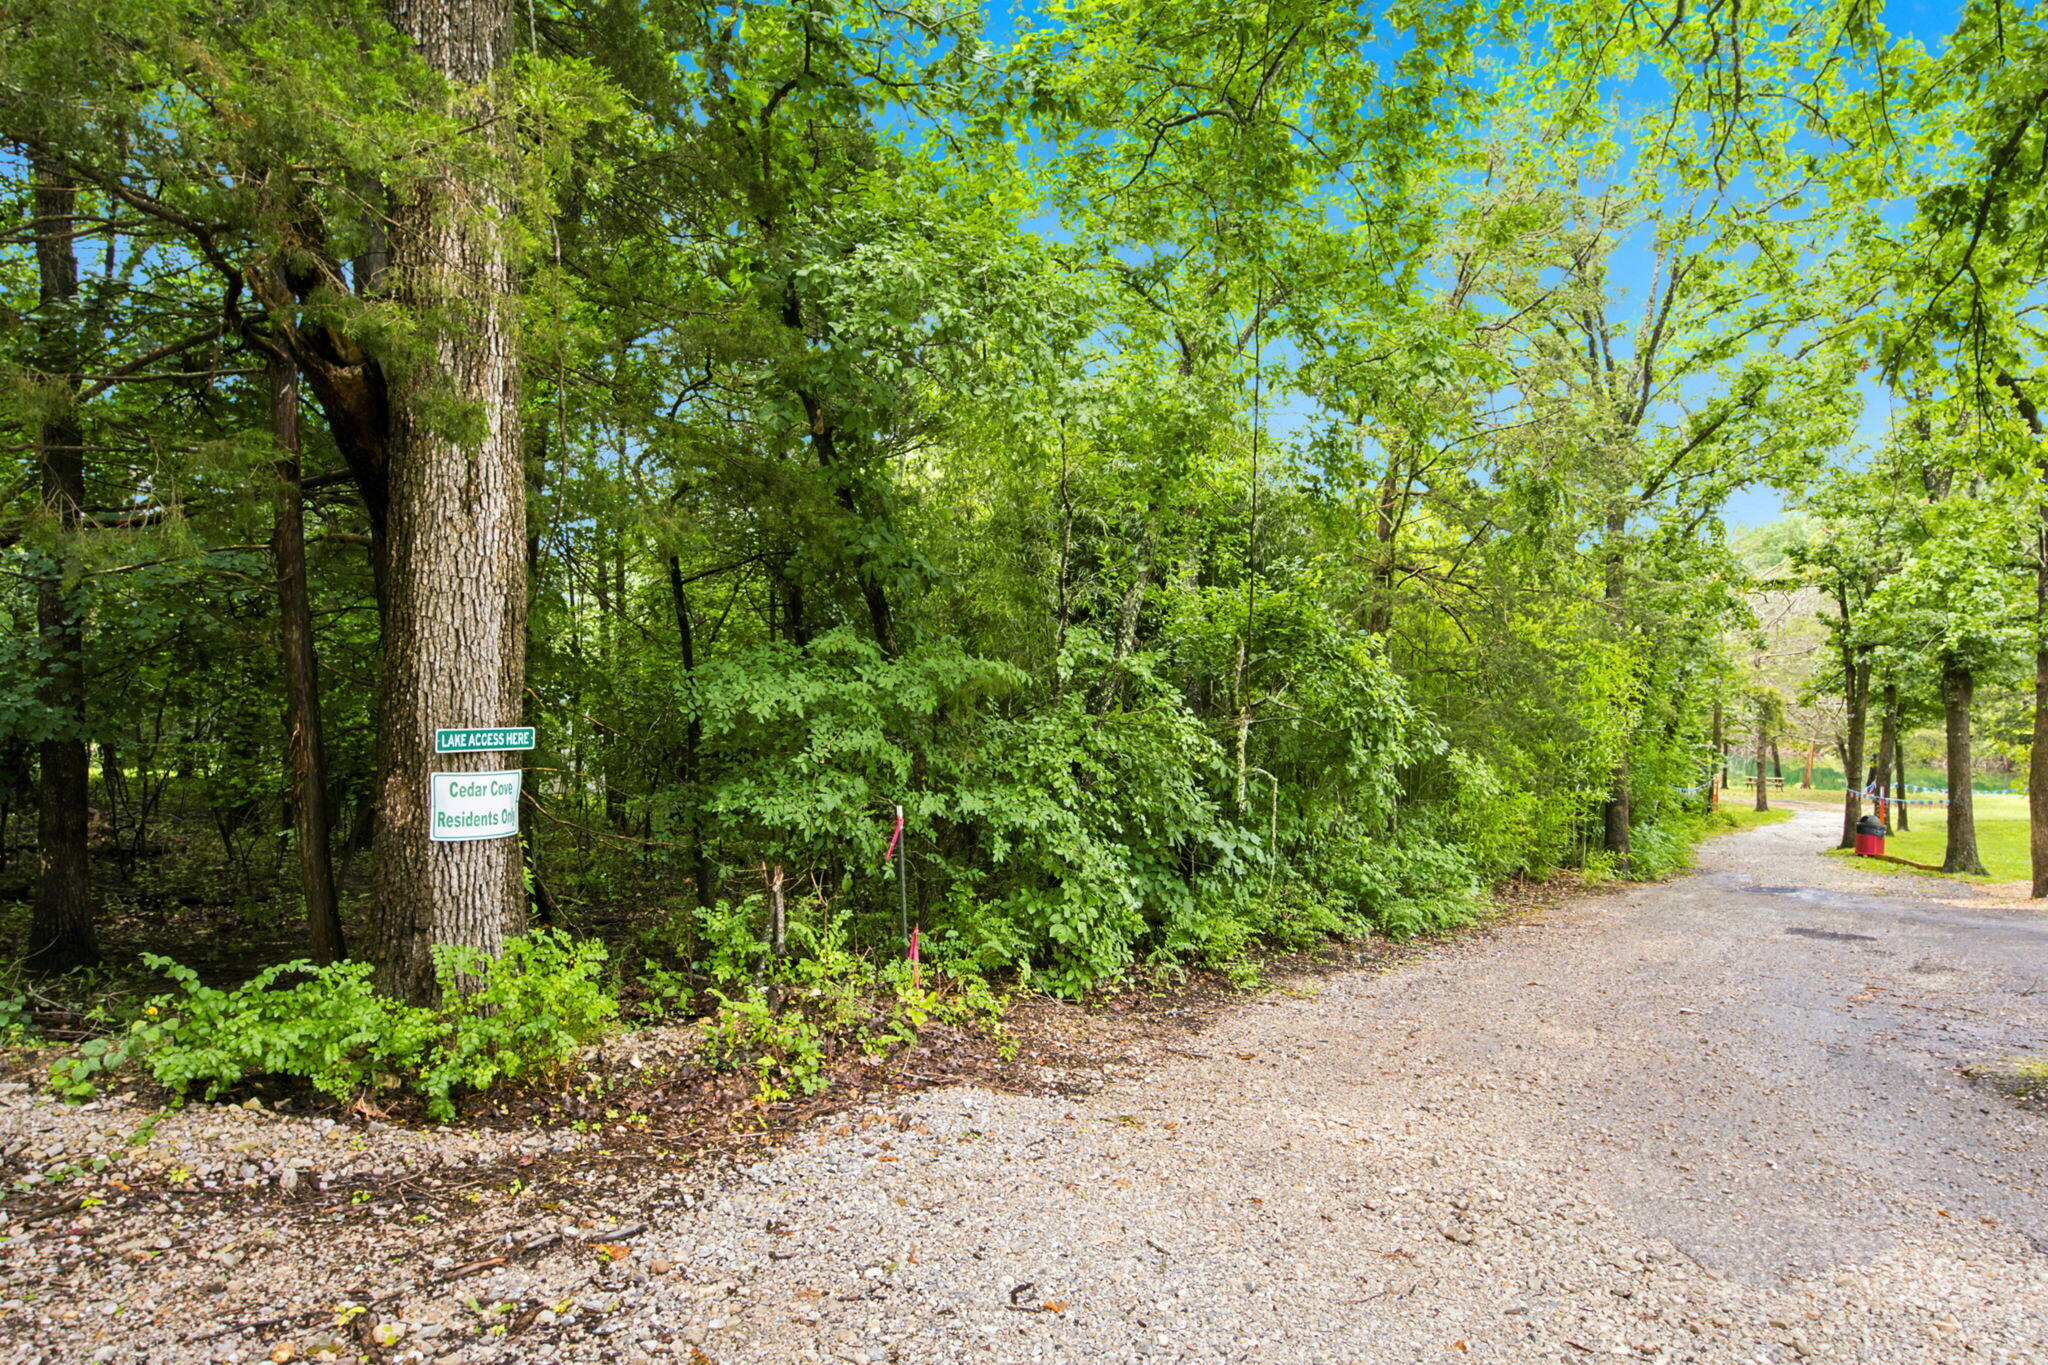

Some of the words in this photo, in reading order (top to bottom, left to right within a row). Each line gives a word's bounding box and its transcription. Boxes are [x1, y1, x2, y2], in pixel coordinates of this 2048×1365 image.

[441, 734, 467, 748] LAKE
[468, 733, 505, 747] ACCESS
[506, 732, 530, 745] HERE
[449, 781, 487, 798] Cedar
[490, 780, 513, 796] Cove
[437, 810, 499, 828] Residents
